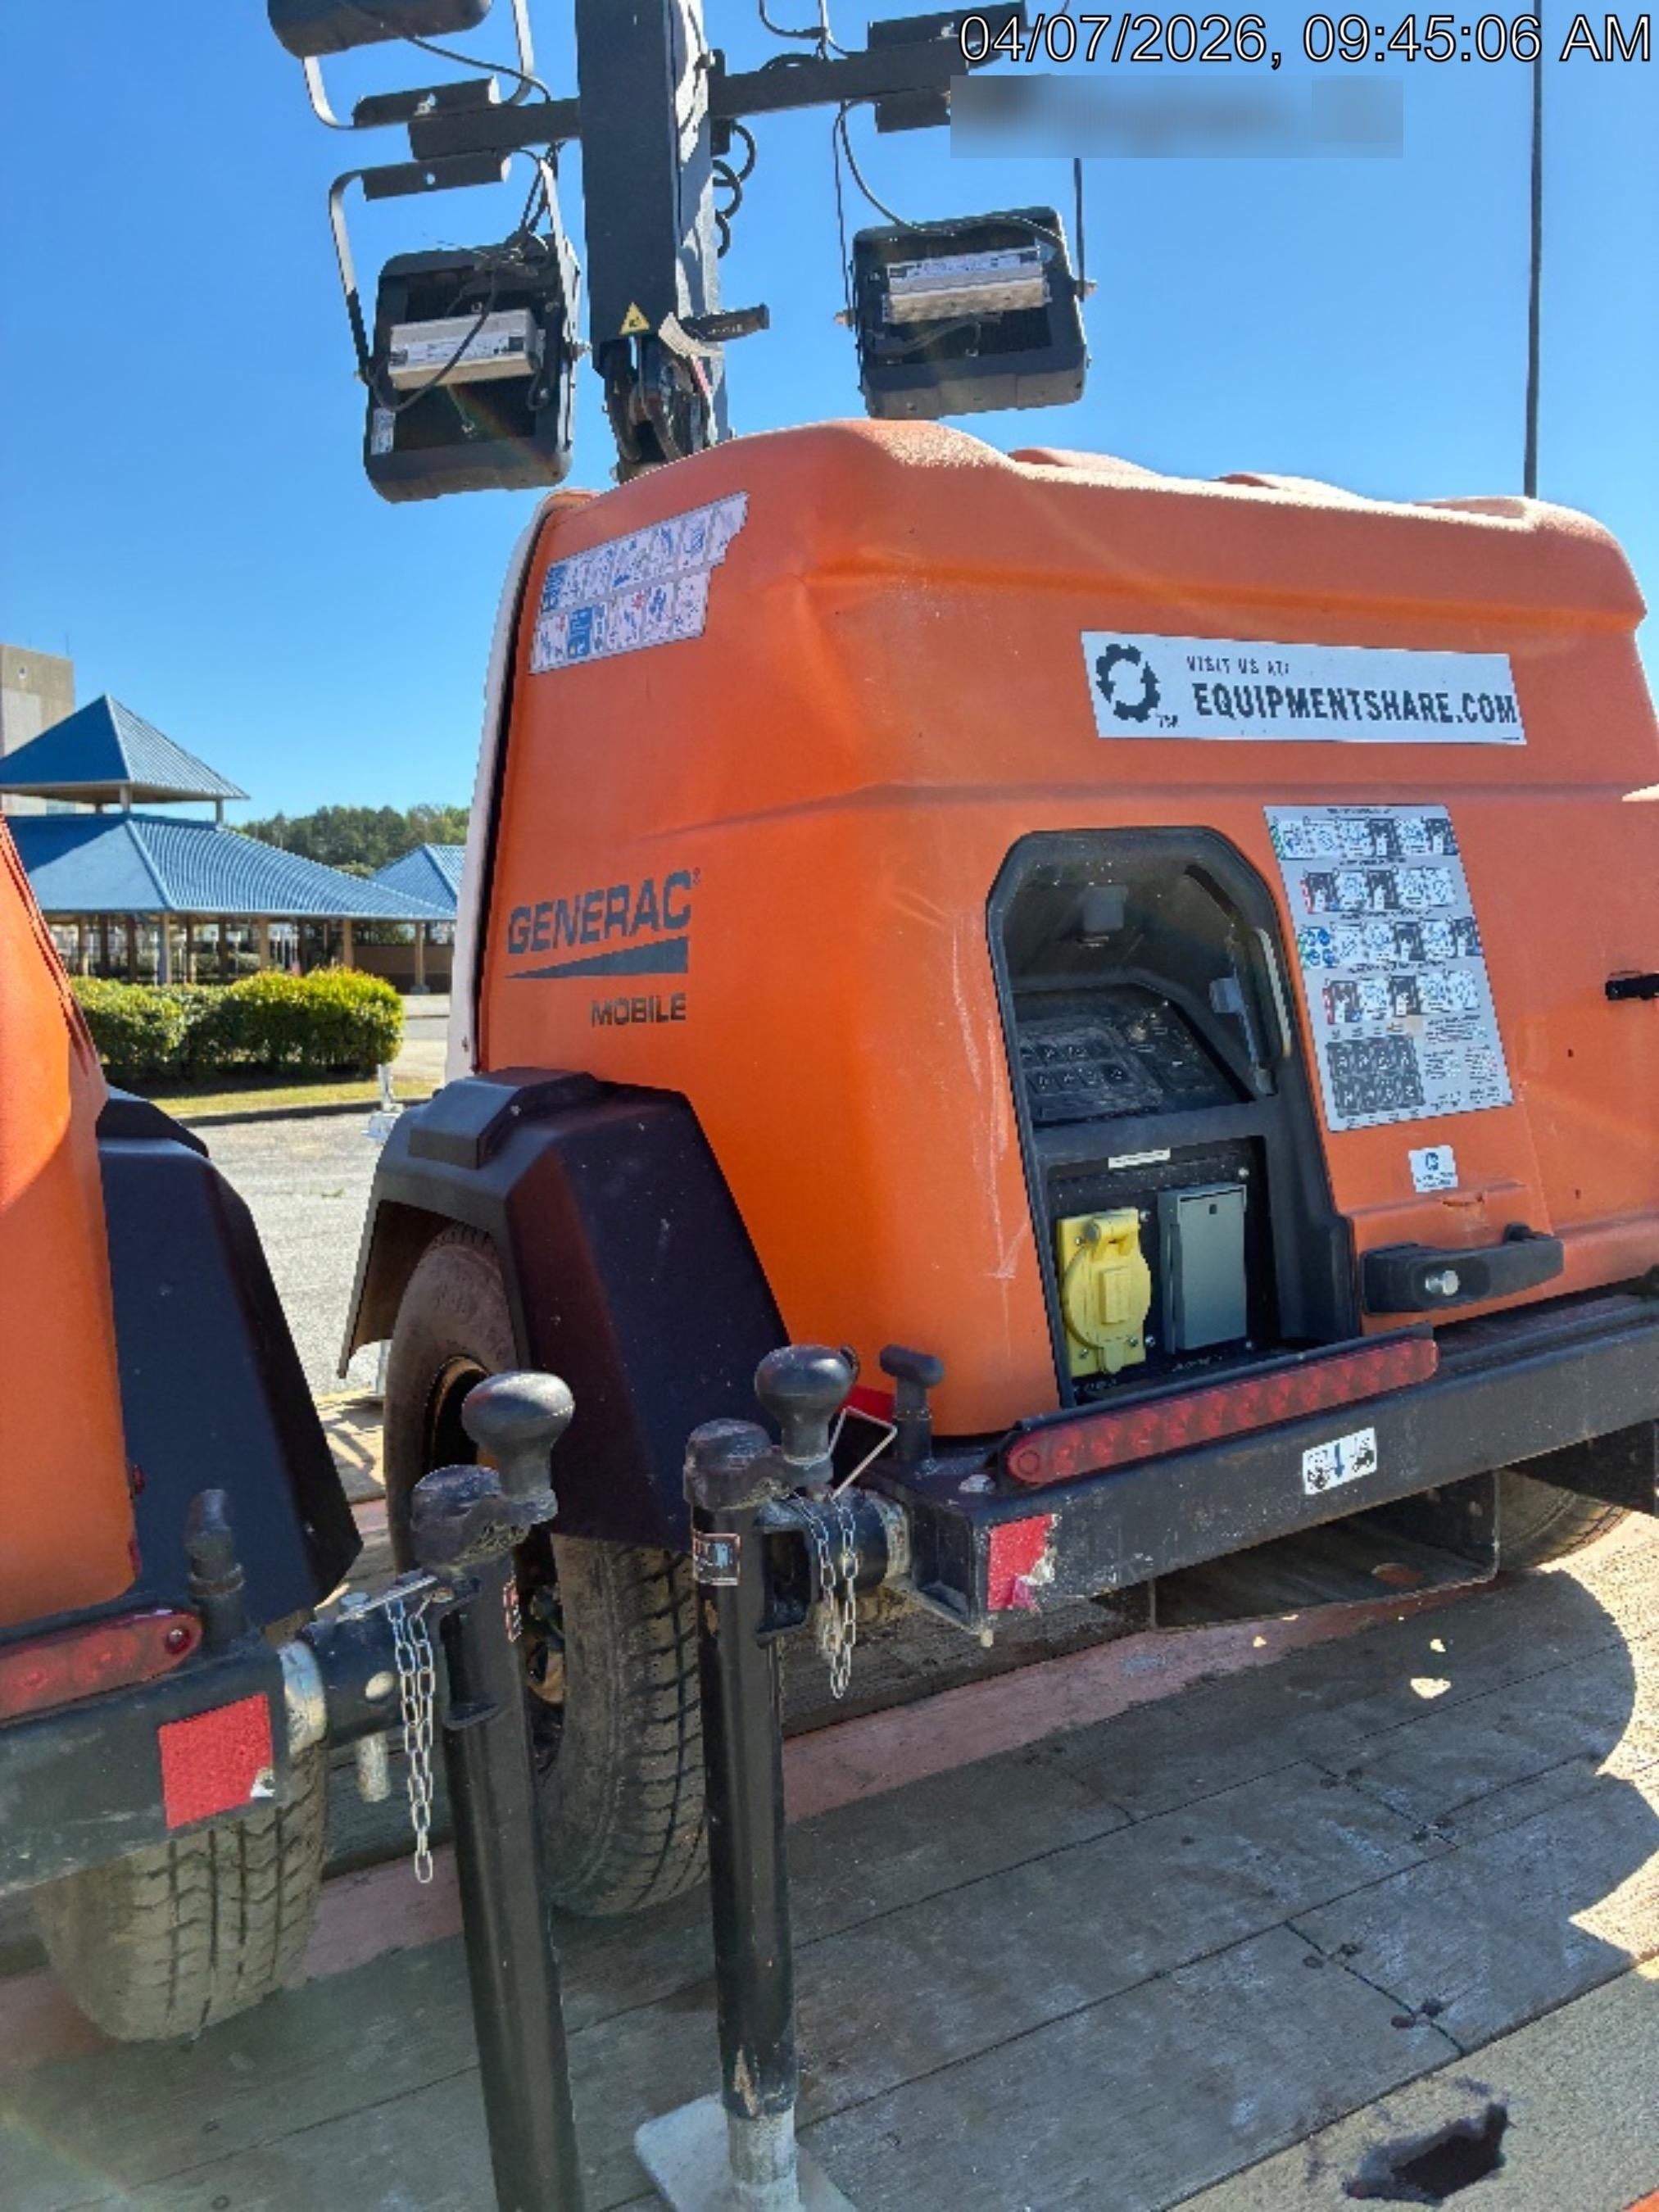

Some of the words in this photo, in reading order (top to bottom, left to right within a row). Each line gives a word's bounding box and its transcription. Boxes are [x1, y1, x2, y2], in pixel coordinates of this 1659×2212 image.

[1187, 655, 1230, 673] VISIT
[1238, 658, 1259, 674] US
[1192, 682, 1517, 723] EQUIPMENTSHARE.COM
[591, 992, 687, 1027] MOBILE
